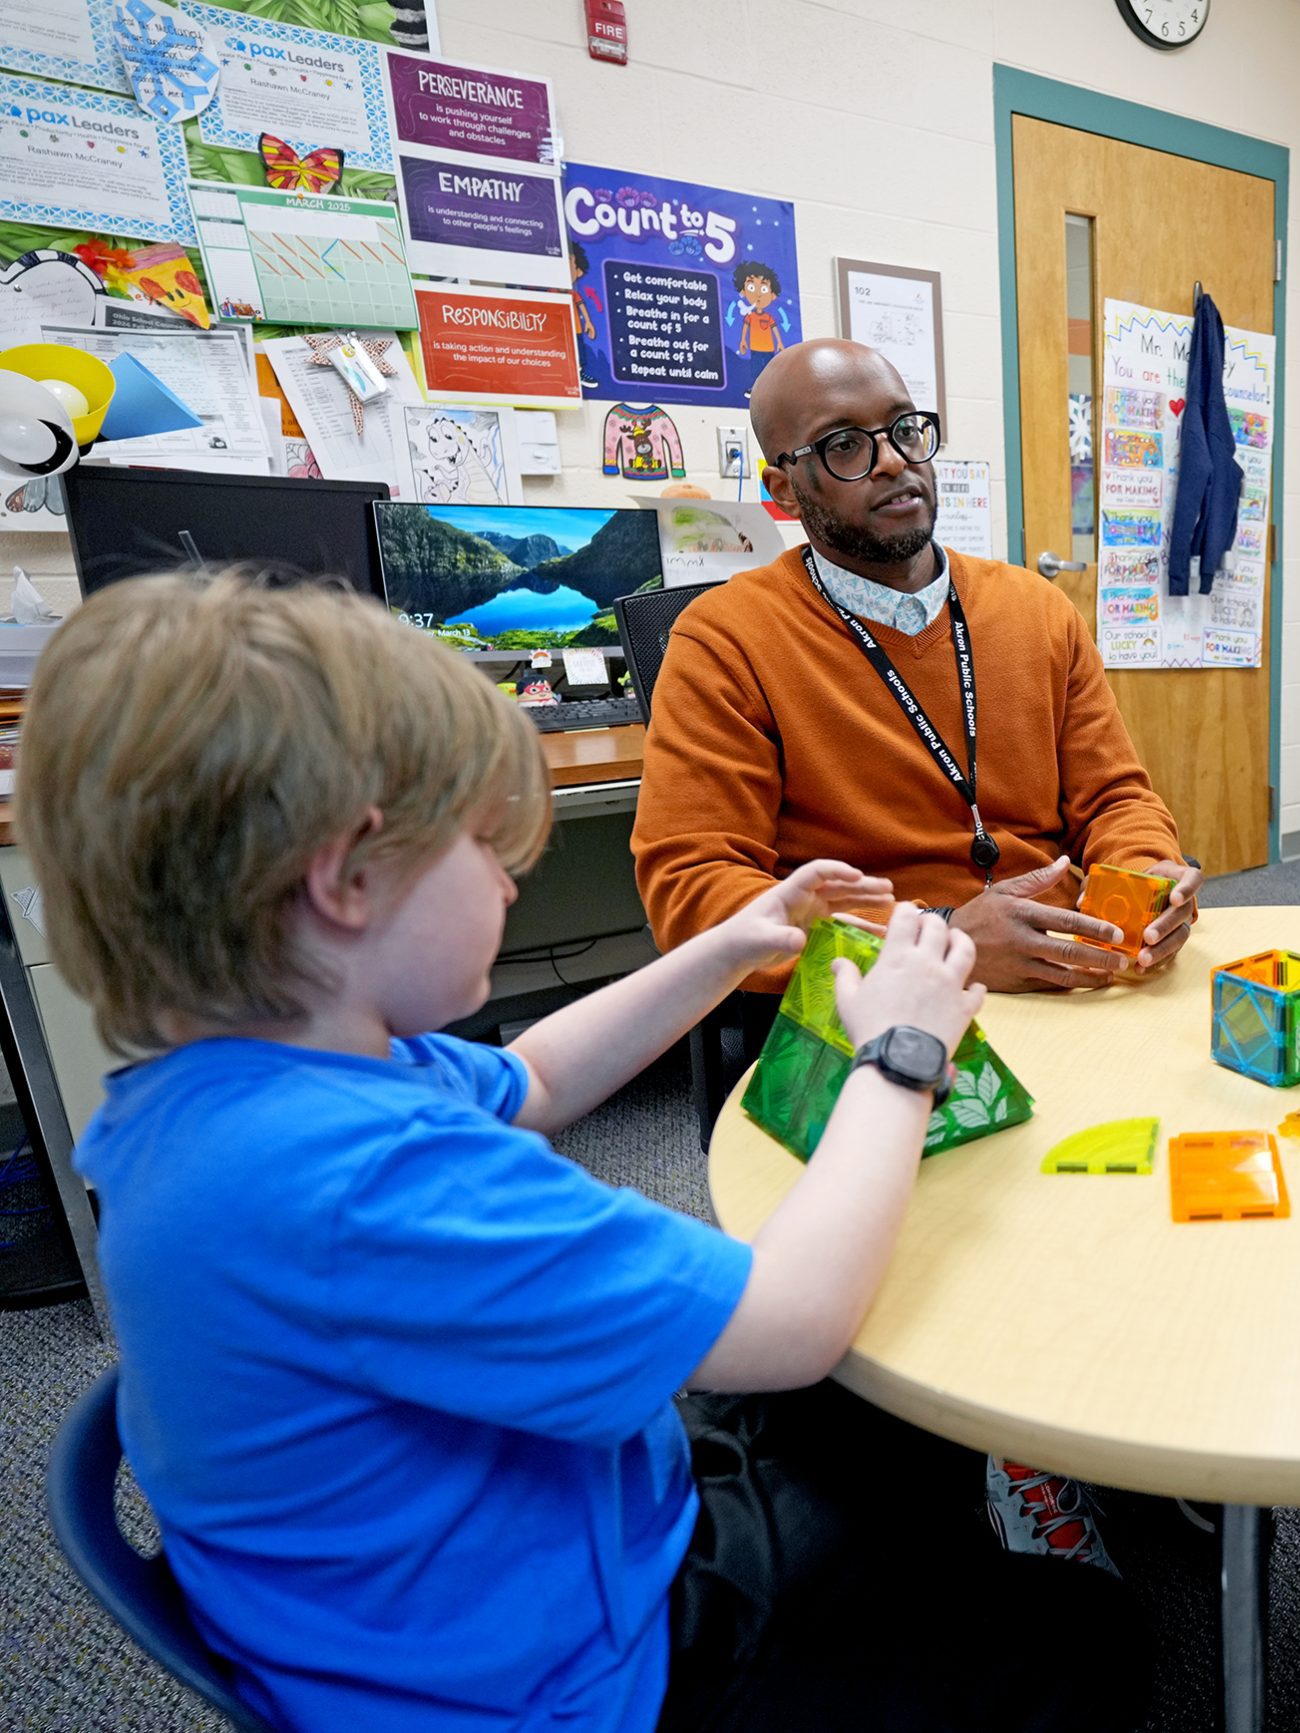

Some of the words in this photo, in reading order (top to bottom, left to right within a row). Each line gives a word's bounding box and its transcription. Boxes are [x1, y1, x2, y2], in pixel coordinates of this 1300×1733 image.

[1145, 8, 1153, 25] 7
[1190, 8, 1198, 23] 4
[595, 22, 624, 39] FIRE
[1161, 21, 1169, 37] 6
[1178, 21, 1186, 37] 5
[249, 42, 287, 60] pax
[287, 51, 345, 72] Leaders
[418, 70, 524, 109] PERSEVERANCE
[26, 108, 70, 126] pax
[71, 116, 140, 139] Leaders
[435, 103, 443, 113] is
[445, 105, 478, 120] pushing
[479, 112, 512, 125] yourself
[419, 112, 428, 121] to
[429, 114, 452, 125] work
[453, 117, 487, 132] through
[487, 125, 532, 139] challenges
[448, 129, 464, 138] and
[466, 131, 506, 145] obstacles
[438, 171, 525, 202] EMPATHY
[286, 197, 324, 209] MARCH
[327, 201, 351, 212] 2025
[427, 205, 435, 213] is
[435, 207, 488, 222] understanding
[489, 215, 503, 223] and
[504, 217, 544, 230] connecting
[442, 217, 451, 225] to
[452, 219, 472, 228] other
[473, 221, 504, 232] people's
[504, 225, 533, 237] feelings
[564, 186, 679, 240] Count
[680, 203, 704, 229] to
[704, 210, 737, 263] 5
[623, 271, 642, 284] Get
[645, 275, 708, 291] comfortable
[854, 286, 871, 296] 102
[624, 288, 654, 301] Relax
[656, 293, 681, 306] your
[683, 295, 707, 310] body
[626, 305, 668, 320] Breathe
[671, 311, 681, 321] in
[683, 312, 700, 324] for
[702, 315, 710, 324] a
[627, 319, 658, 331] count
[660, 322, 673, 334] of
[675, 322, 682, 333] 5
[433, 340, 441, 350] is
[441, 342, 467, 352] taking
[468, 344, 493, 353] action
[495, 345, 510, 354] and
[511, 346, 567, 360] understanding
[628, 334, 670, 349] Breathe
[672, 340, 690, 350] out
[692, 341, 709, 353] for
[1140, 333, 1164, 358] Mr.
[453, 353, 467, 362] the
[468, 354, 496, 365] impact
[497, 356, 506, 364] of
[506, 357, 520, 365] our
[521, 357, 552, 368] choices
[629, 348, 638, 358] a
[640, 350, 670, 361] count
[672, 351, 685, 364] of
[686, 352, 694, 362] 5
[631, 363, 667, 377] Repeat
[668, 367, 692, 378] until
[694, 369, 719, 380] calm
[1112, 355, 1133, 379] You
[1142, 369, 1161, 384] are
[1166, 367, 1186, 388] the
[1106, 485, 1123, 494] FOR
[1125, 486, 1158, 496] MAKING
[437, 629, 461, 637] March
[462, 629, 471, 637] 13
[850, 619, 877, 649] Akron
[955, 621, 967, 651] Akron
[1111, 640, 1137, 650] LUCKY
[960, 654, 973, 689] Public
[965, 691, 978, 737] Schools
[886, 669, 918, 714] Schools
[915, 714, 942, 751] Public
[938, 750, 964, 782] Akron
